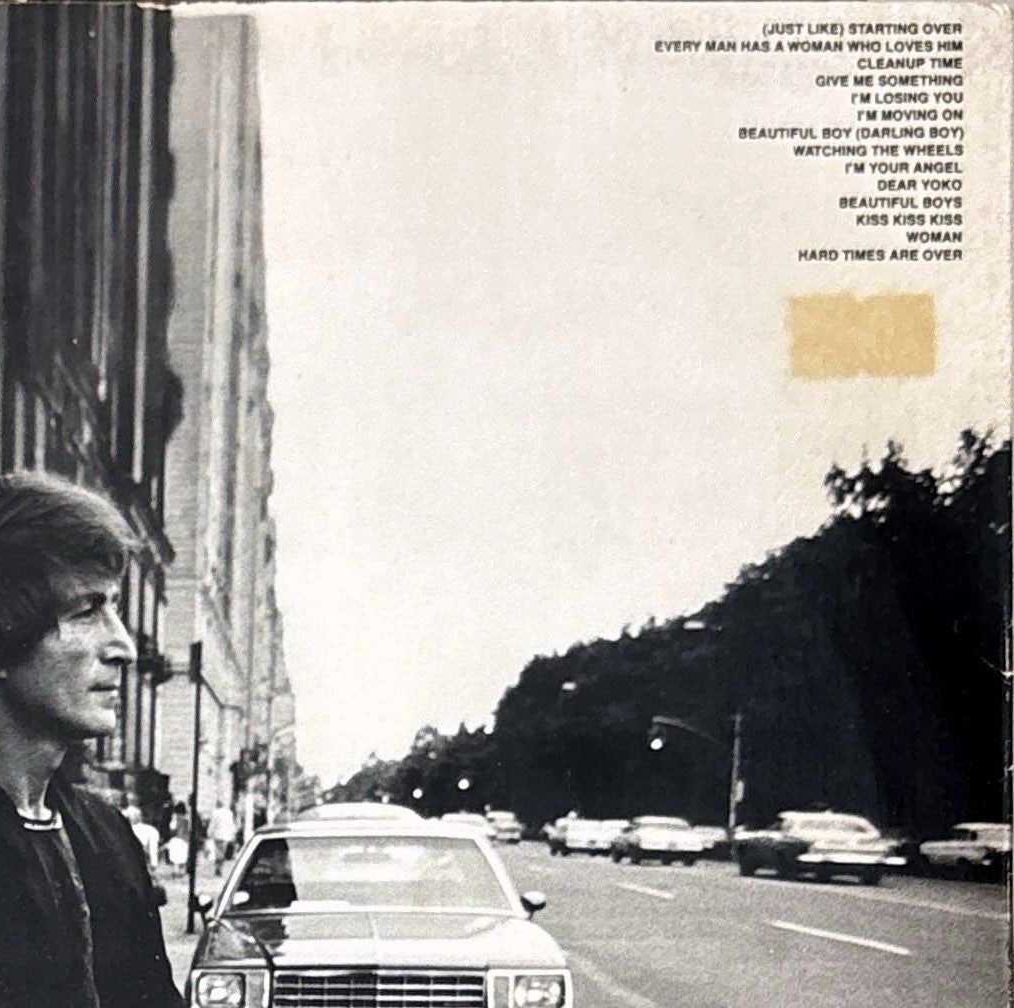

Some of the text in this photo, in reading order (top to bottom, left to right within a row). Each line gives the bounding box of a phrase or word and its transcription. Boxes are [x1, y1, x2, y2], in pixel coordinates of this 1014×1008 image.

[762, 23, 962, 35] (JUST LIKE) STARTING OVER
[655, 41, 963, 52] EVERY MAN HAS A WOMAN WHO LOVES HIM
[857, 58, 962, 69] CLEANUP TIME
[816, 75, 963, 87] GIVE ME SOMETHING
[851, 92, 963, 104] I'M LOSING YOU
[857, 110, 963, 121] I'M MOVING ON
[738, 127, 964, 139] BEAUTIFUL BOY (DARLING BOY)
[793, 145, 964, 157] WATCHING THE WHEELS
[845, 162, 962, 174] I'M YOUR ANGEL
[878, 179, 962, 191] DEAR YOKO
[839, 197, 962, 209] BEAUTIFUL BOYS
[856, 214, 962, 226] KISS KISS KISS
[906, 232, 962, 242] WOMAN
[798, 250, 962, 261] HARD TIMES ARE OVER
